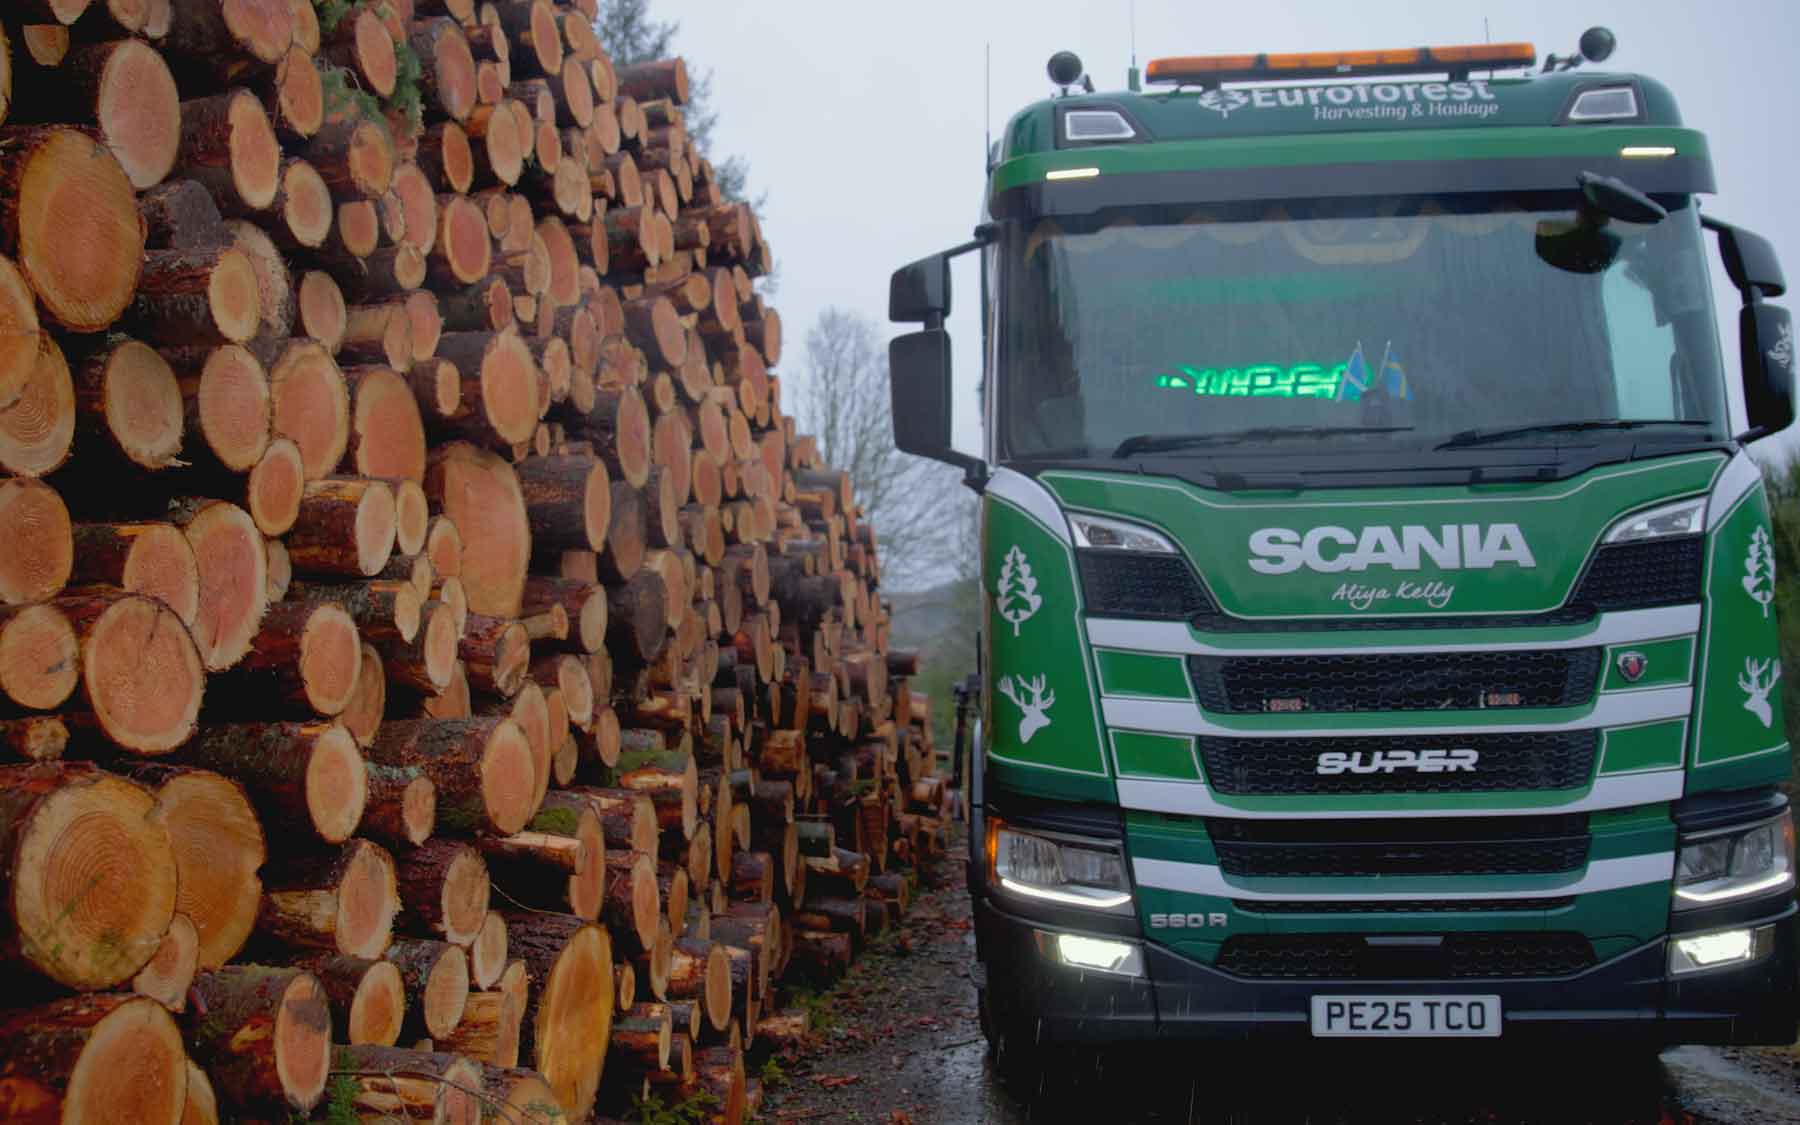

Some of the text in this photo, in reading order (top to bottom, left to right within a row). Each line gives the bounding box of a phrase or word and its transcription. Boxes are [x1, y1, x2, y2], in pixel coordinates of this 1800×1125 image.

[1251, 80, 1495, 108] Euroforest
[1314, 100, 1499, 121] Harvesting & Haulage
[1248, 523, 1537, 575] SCANIA
[1331, 581, 1454, 610] Aliya Kelly
[1316, 749, 1480, 775] SUPER
[1150, 912, 1228, 928] 560 R
[1327, 1002, 1486, 1030] PE25 TCO
